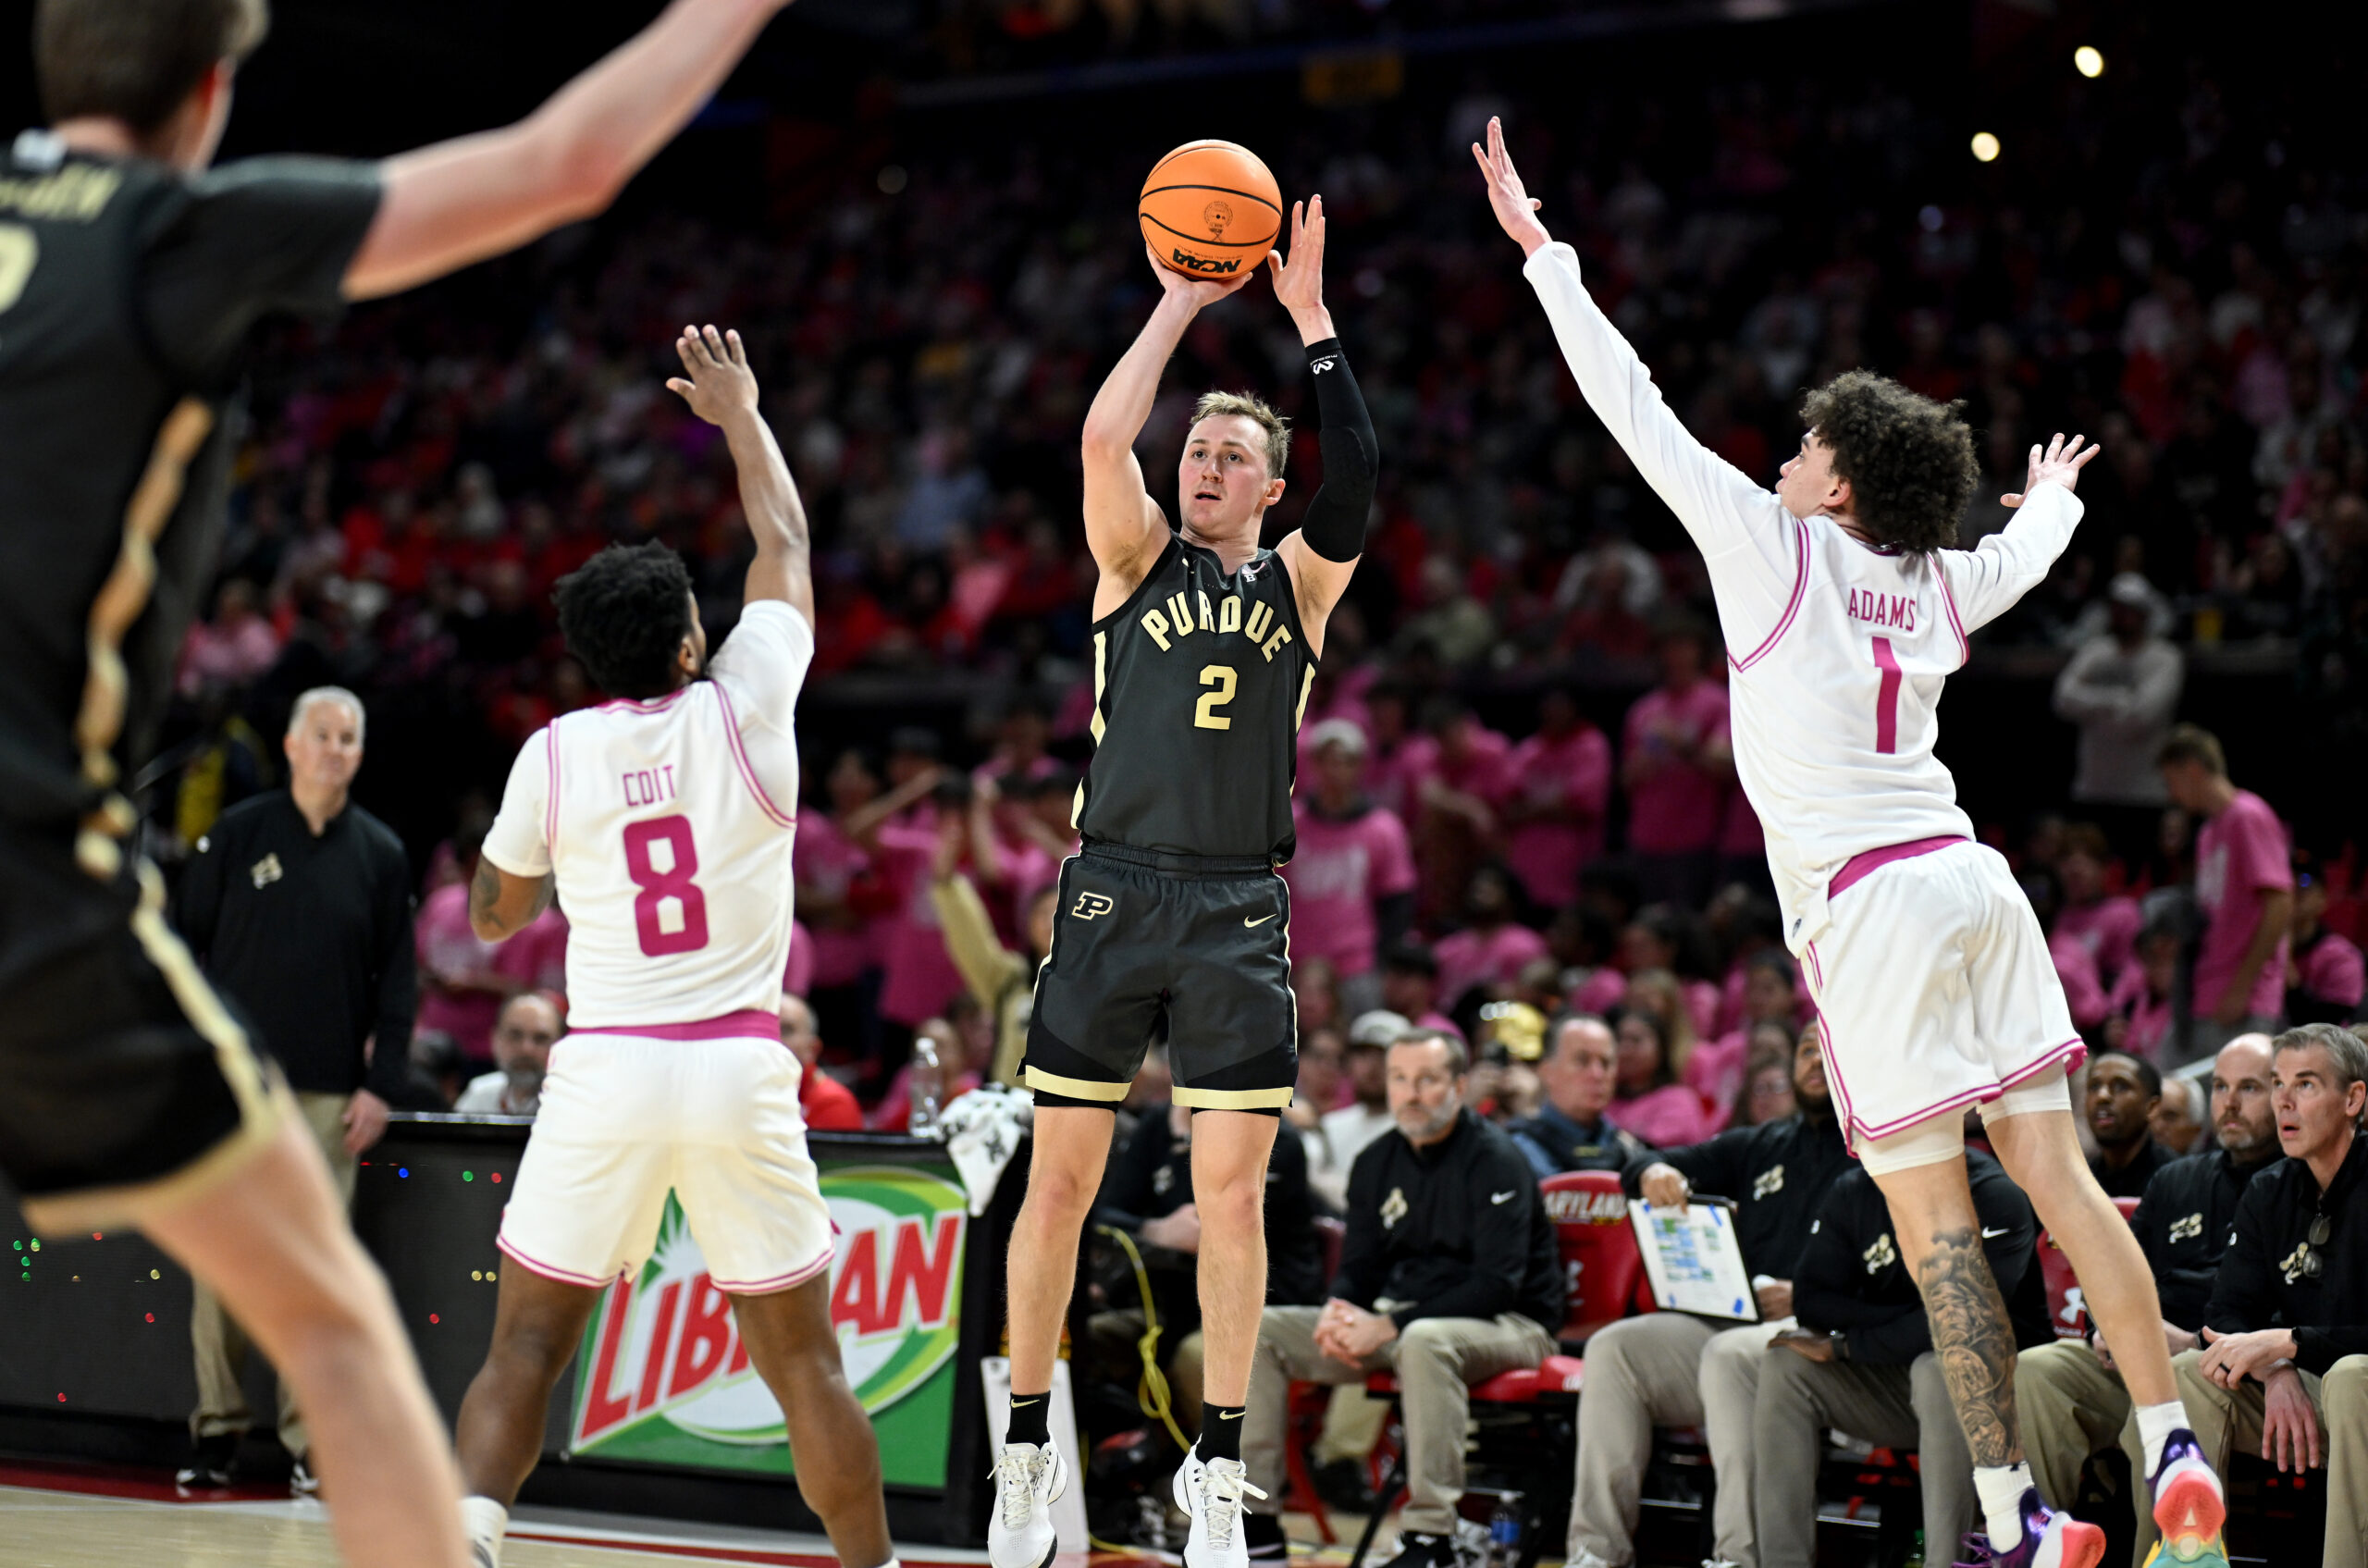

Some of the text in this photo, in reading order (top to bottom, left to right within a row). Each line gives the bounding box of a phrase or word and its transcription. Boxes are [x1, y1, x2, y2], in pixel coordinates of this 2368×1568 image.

[1172, 248, 1242, 273] NCAA
[1140, 589, 1293, 663] PURDUE
[1847, 587, 1916, 632] ADAMS
[1193, 664, 1239, 731] 2
[1871, 636, 1903, 755] 1
[623, 764, 675, 807] COIT
[623, 813, 709, 957] 8
[1544, 1190, 1628, 1220] ARYLAND
[580, 1216, 961, 1440] LIBAN
